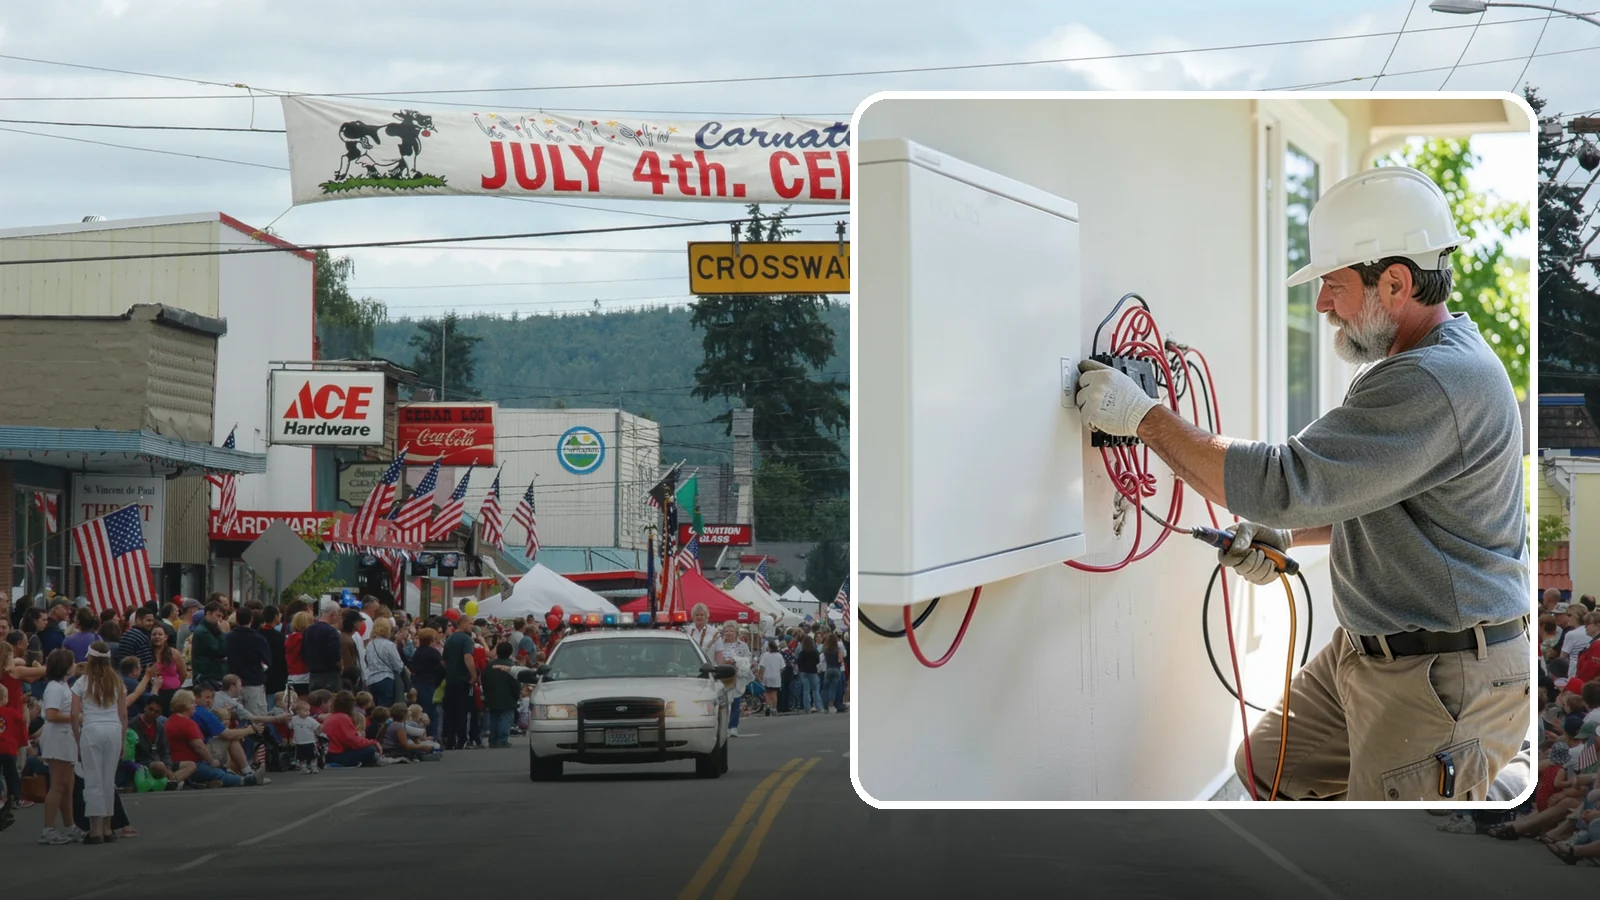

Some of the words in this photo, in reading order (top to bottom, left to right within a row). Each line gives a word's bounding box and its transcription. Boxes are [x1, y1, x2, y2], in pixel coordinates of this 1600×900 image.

[481, 142, 604, 193] JULY
[633, 150, 746, 198] 4th.
[697, 254, 850, 280] CROSSWA
[283, 380, 373, 420] ACE
[406, 409, 452, 422] CEDAR
[283, 421, 370, 436] Hardware
[83, 485, 93, 494] St.
[95, 485, 123, 495] Vincent
[126, 485, 135, 495] de
[137, 486, 155, 495] Paul
[688, 526, 741, 535] CRNATION
[699, 535, 730, 543] GLASS
